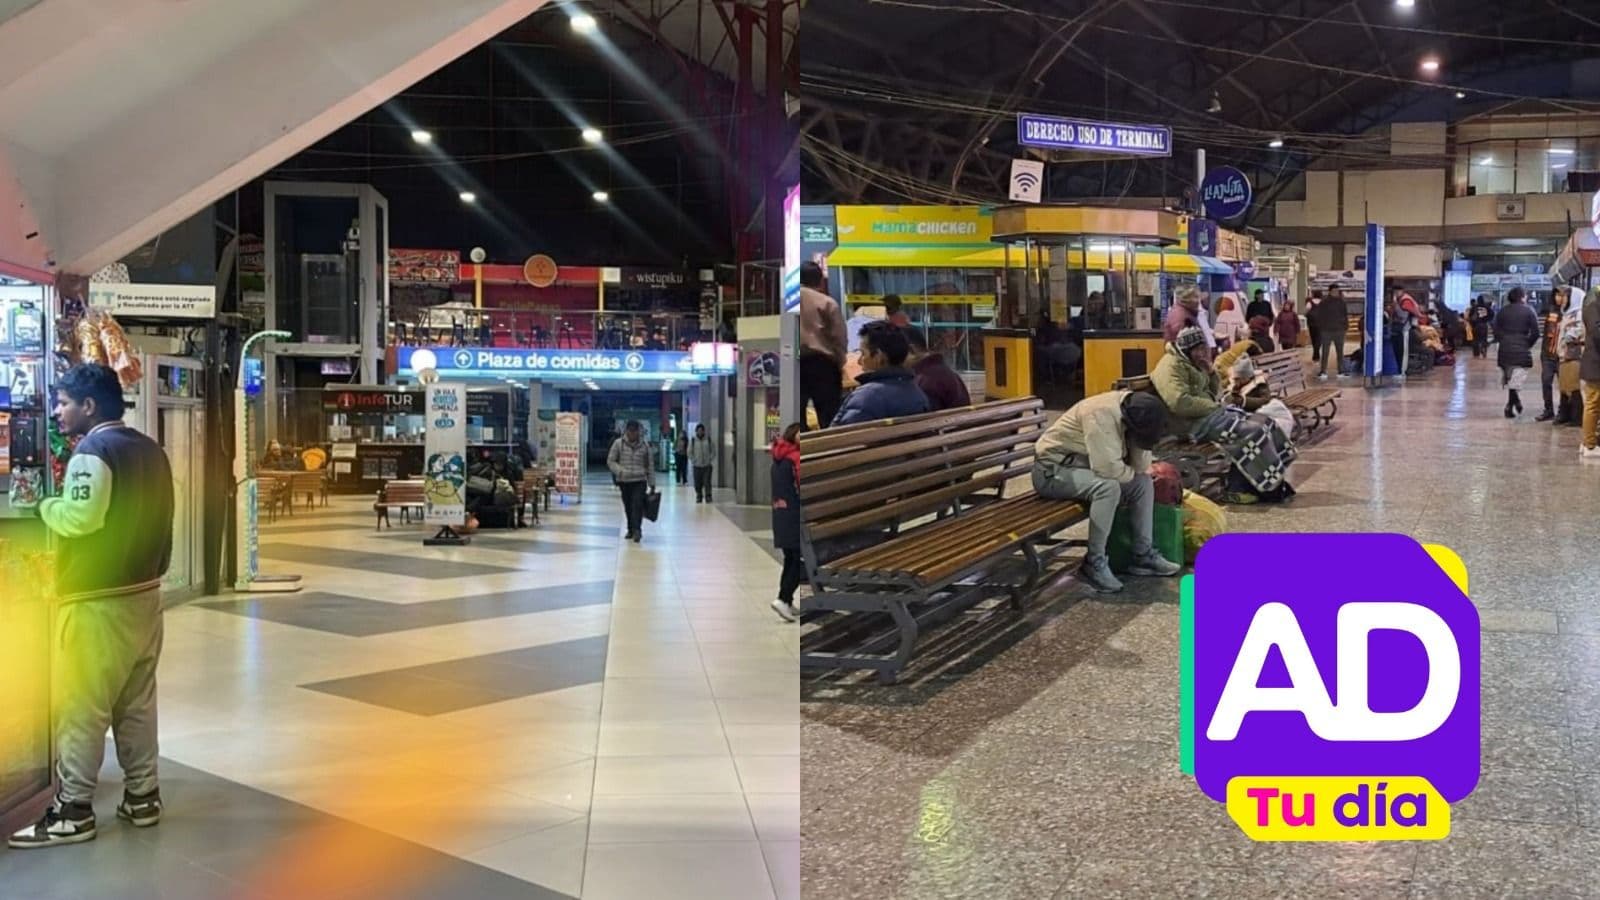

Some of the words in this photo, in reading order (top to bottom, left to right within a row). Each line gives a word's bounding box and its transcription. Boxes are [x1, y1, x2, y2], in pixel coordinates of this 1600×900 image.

[1026, 121, 1074, 142] DERECHO
[1078, 126, 1097, 144] USO
[1100, 128, 1113, 146] DE
[1116, 130, 1165, 149] TERMINAL
[477, 353, 522, 368] Plaza
[526, 353, 548, 369] de
[551, 354, 621, 370] comidas
[71, 485, 91, 501] 03
